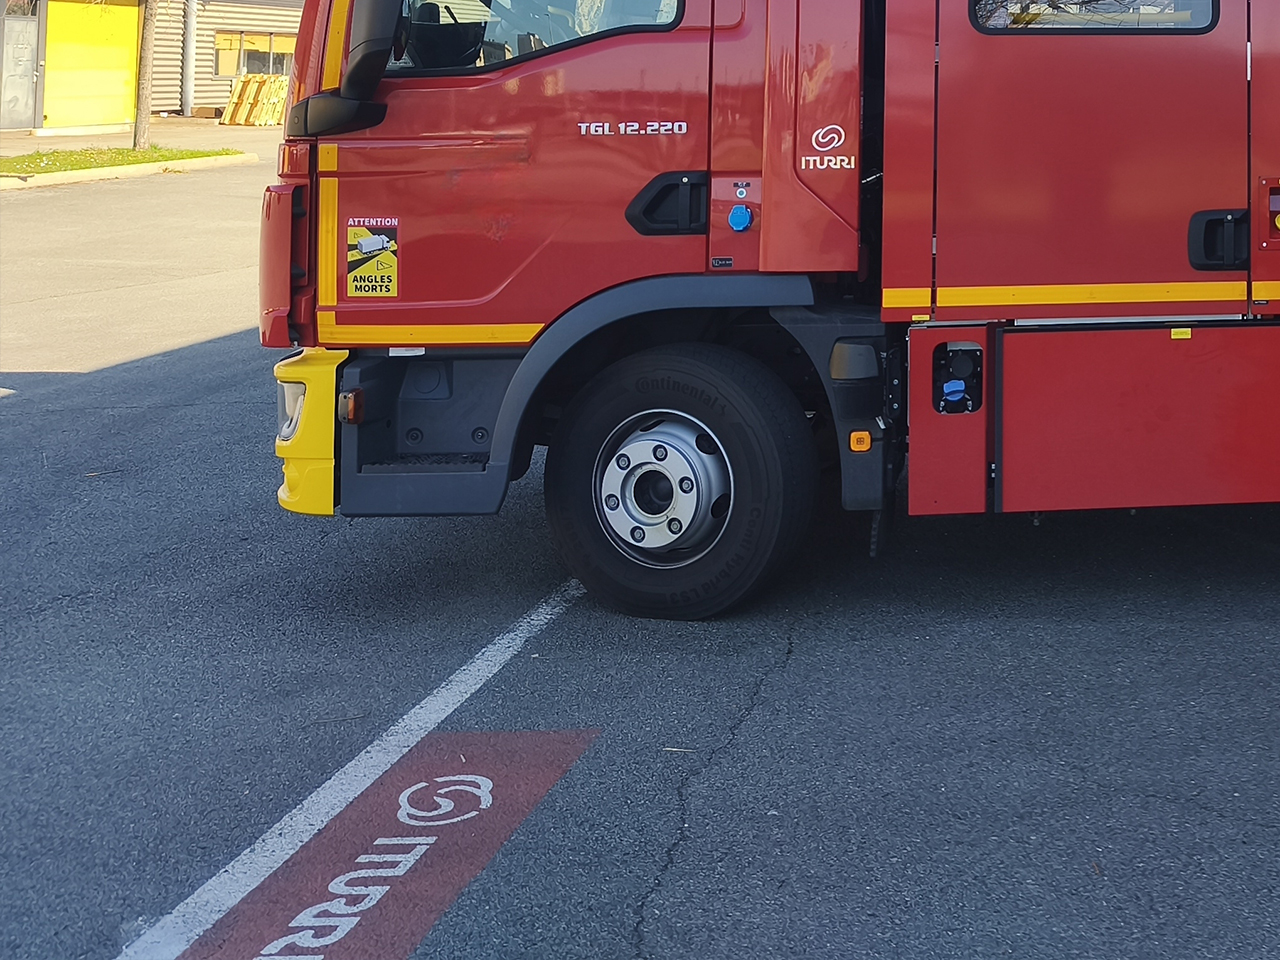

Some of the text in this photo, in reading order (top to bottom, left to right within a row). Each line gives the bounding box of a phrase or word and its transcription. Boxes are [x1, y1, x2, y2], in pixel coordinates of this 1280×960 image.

[577, 121, 688, 136] TGL 12.220
[801, 155, 856, 170] ITURRI
[347, 217, 399, 227] ATTENTION
[352, 274, 393, 284] ANGLES
[354, 284, 391, 293] MORTS
[635, 375, 719, 411] Continental
